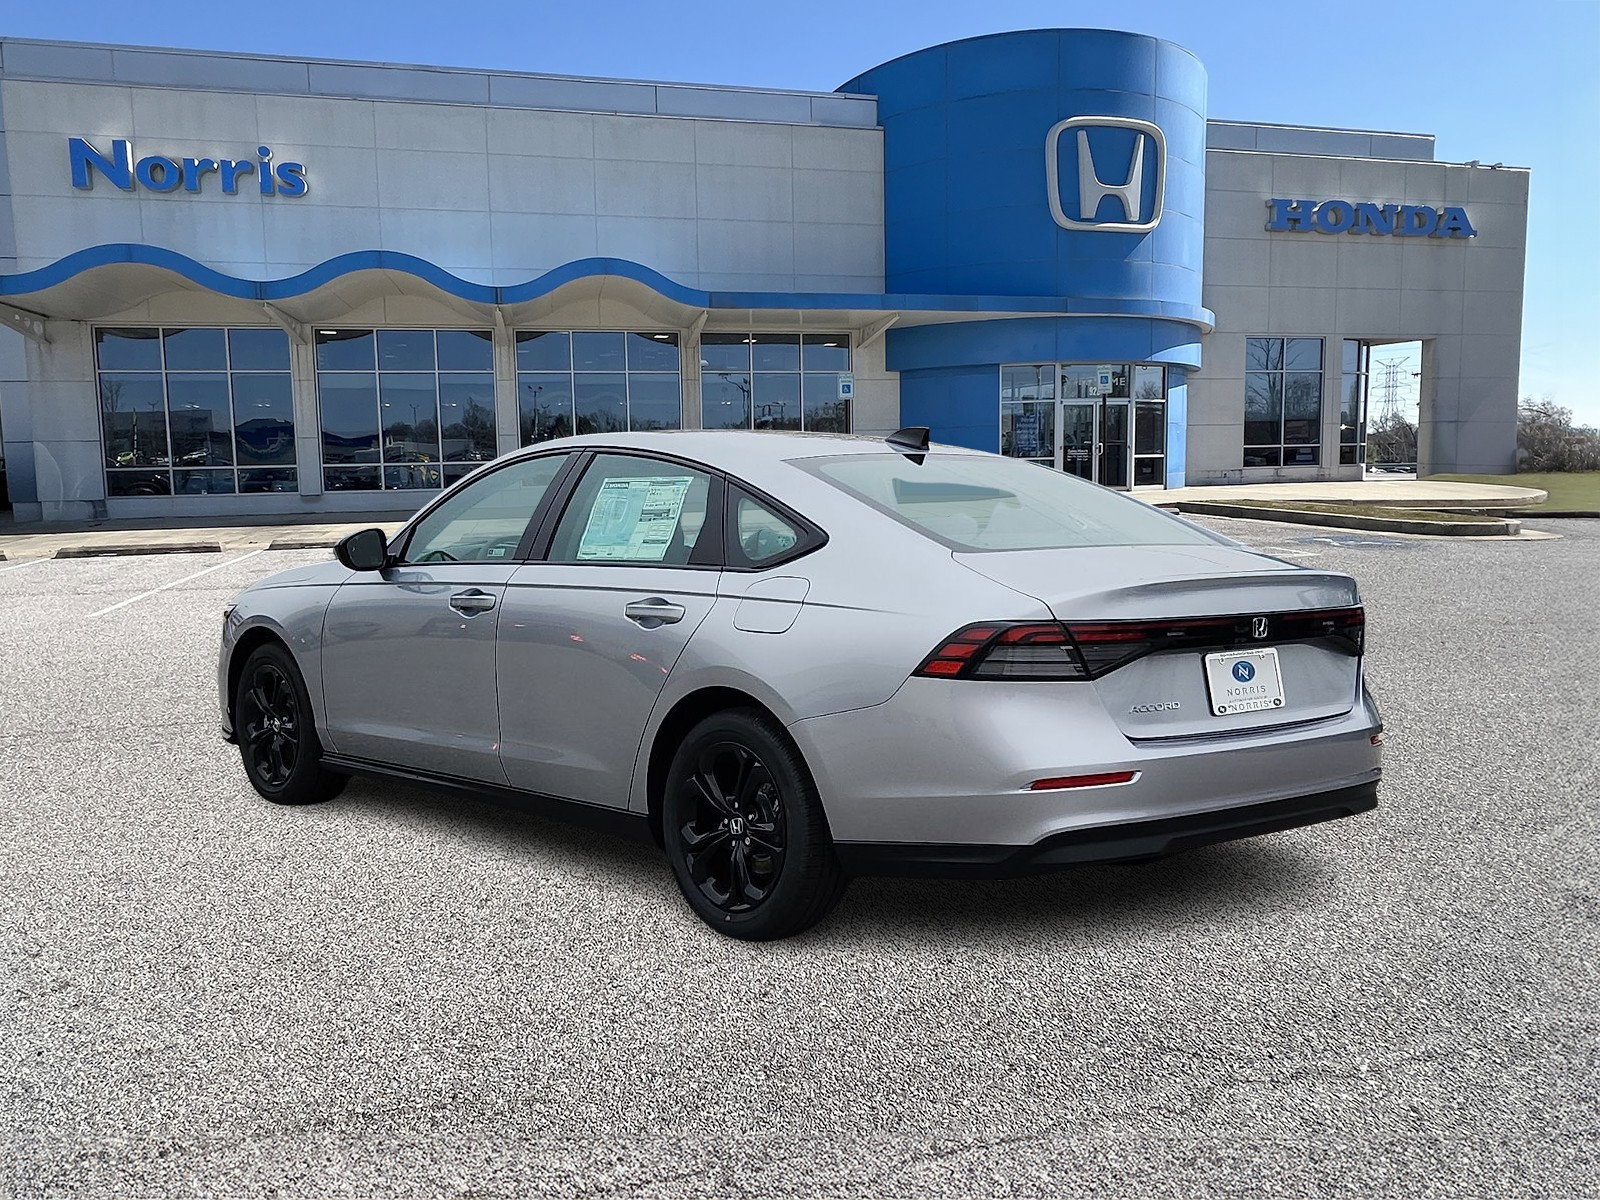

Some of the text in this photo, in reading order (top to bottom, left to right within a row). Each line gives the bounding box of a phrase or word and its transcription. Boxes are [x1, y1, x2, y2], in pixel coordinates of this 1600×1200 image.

[68, 137, 309, 198] Norris
[1266, 198, 1478, 239] HONDA
[1227, 685, 1266, 697] NORRIS
[1129, 702, 1180, 714] ACCORD
[1231, 700, 1270, 711] NORRIS
